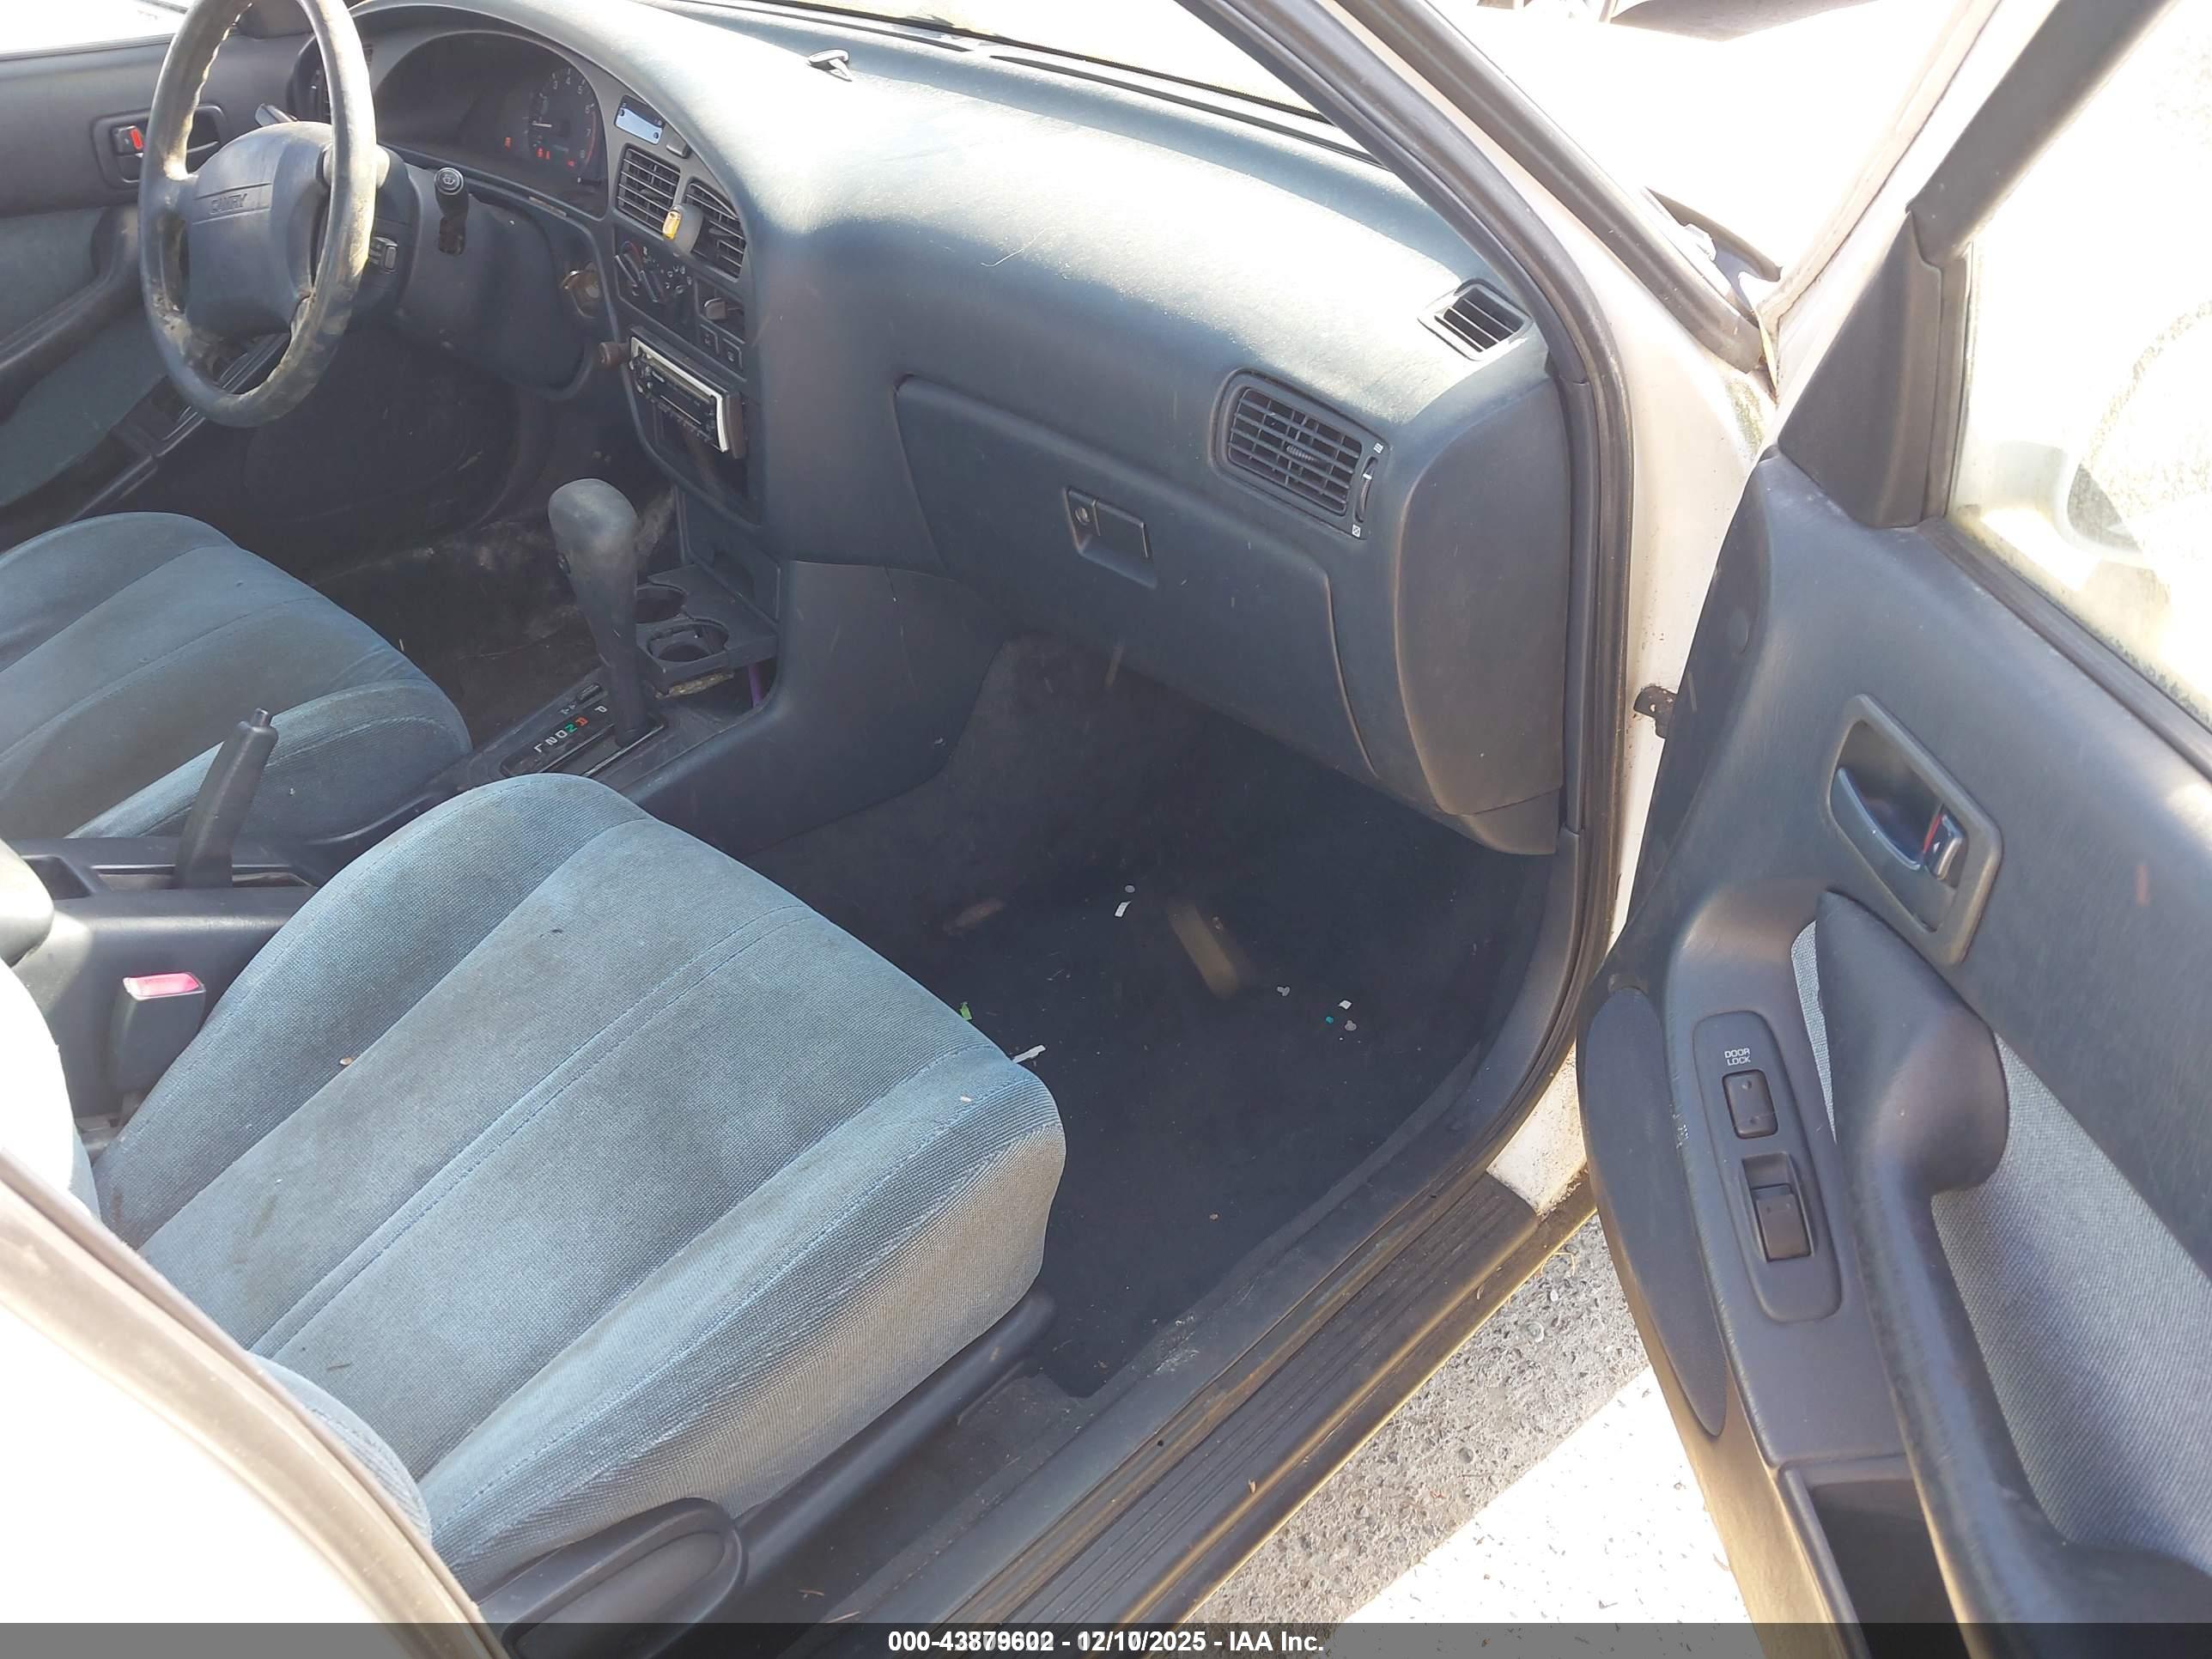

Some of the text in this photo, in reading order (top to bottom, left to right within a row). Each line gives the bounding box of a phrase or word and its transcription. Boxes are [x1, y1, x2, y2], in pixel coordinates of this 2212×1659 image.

[594, 705, 608, 714] P
[1724, 1048, 1751, 1059] DOOR
[1727, 1055, 1751, 1066] LOCK
